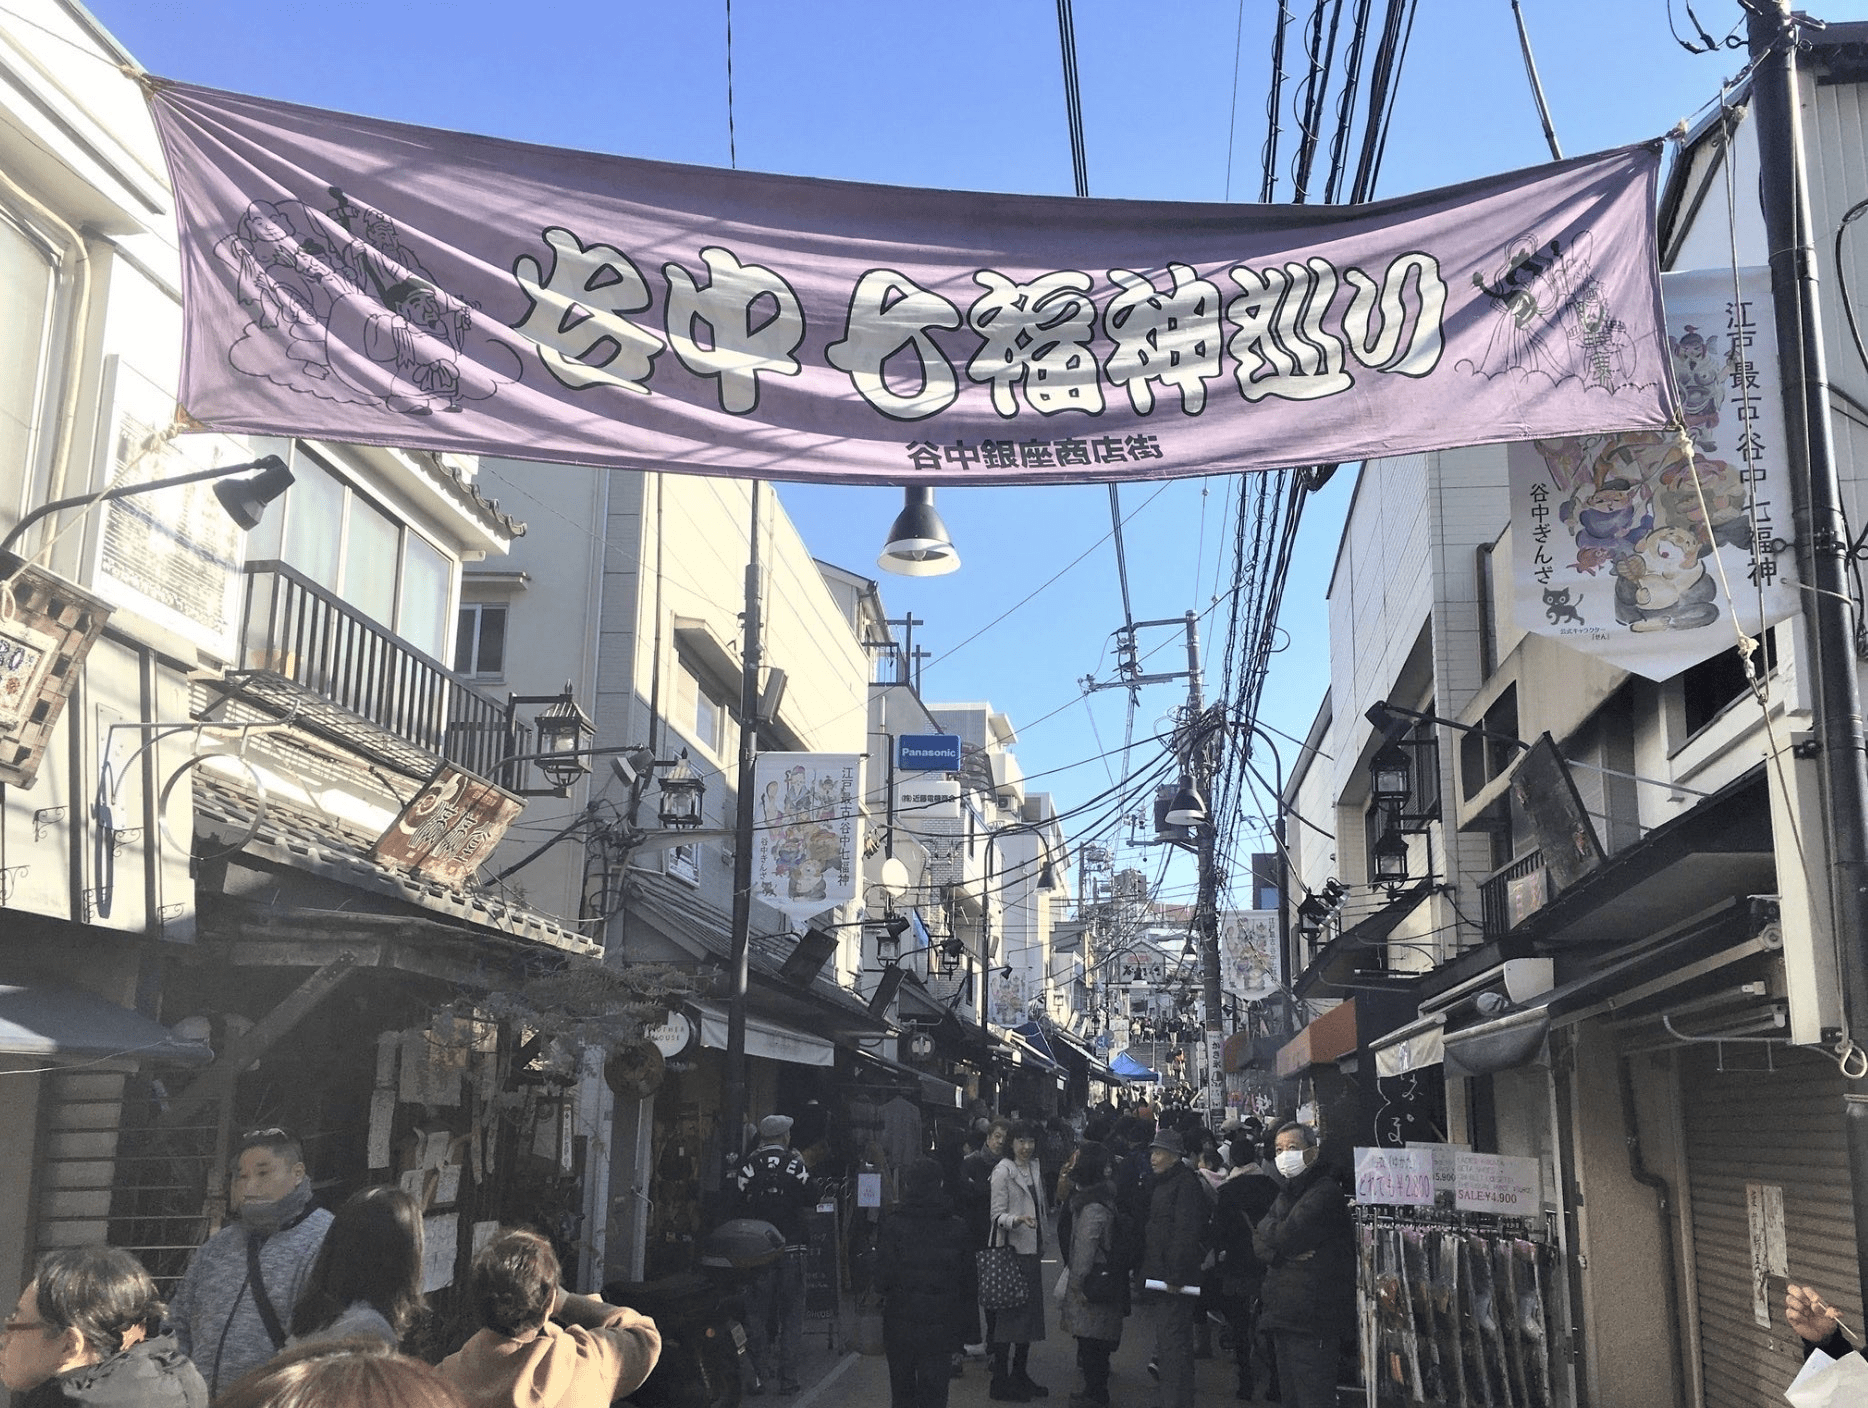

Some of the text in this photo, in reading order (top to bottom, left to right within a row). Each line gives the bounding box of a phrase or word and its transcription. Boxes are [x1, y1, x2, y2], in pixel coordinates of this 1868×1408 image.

[905, 433, 1165, 471] 谷中銀座商店街
[1529, 482, 1554, 585] 谷中ぎんざ
[901, 747, 956, 757] Panasonic
[737, 1156, 810, 1192] AVREX
